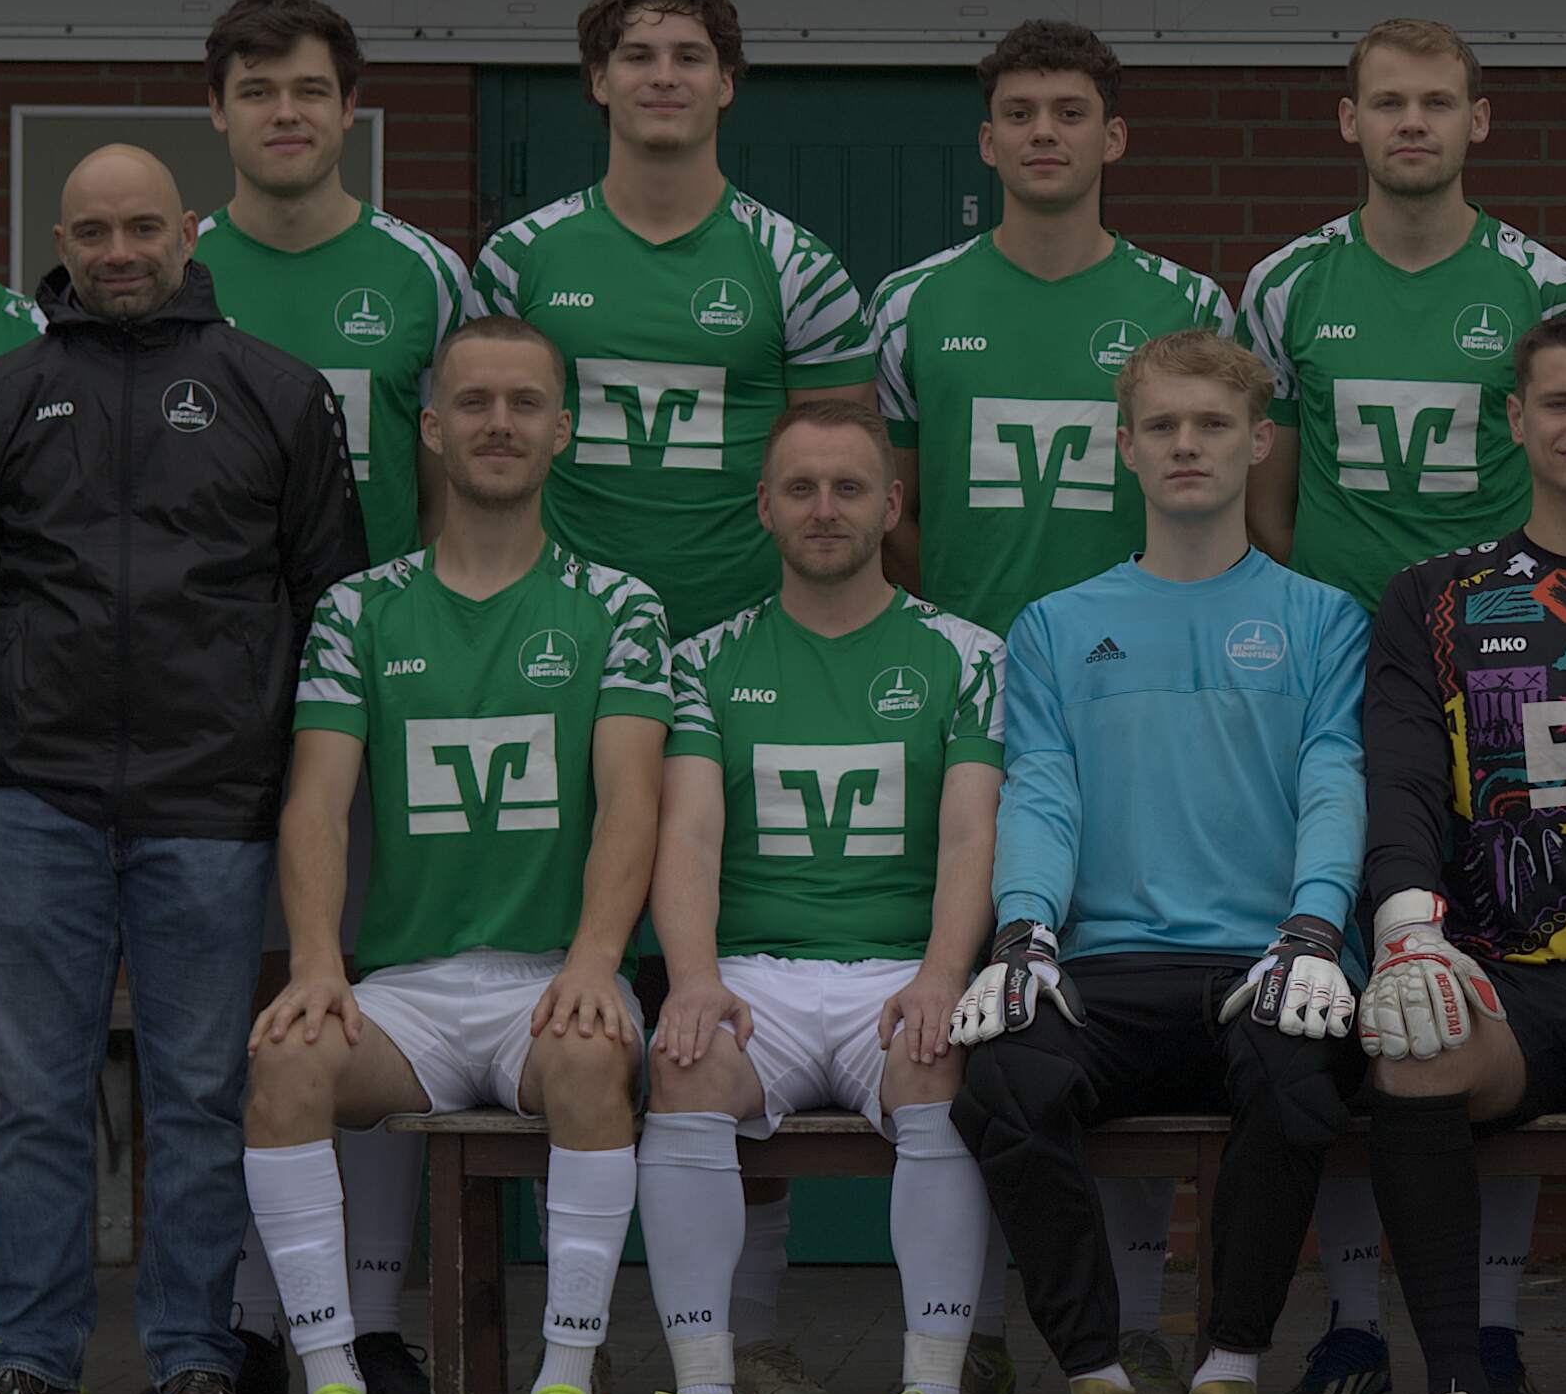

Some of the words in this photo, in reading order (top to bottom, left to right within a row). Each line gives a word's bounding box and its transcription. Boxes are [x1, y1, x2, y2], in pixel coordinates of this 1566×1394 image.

[962, 195, 978, 225] 5
[549, 291, 594, 307] JAKO
[1315, 324, 1356, 340] JAKO
[941, 336, 987, 352] JAKO
[36, 401, 74, 421] JAKO
[1480, 636, 1527, 654] JAKO
[1086, 651, 1126, 664] adidas
[384, 658, 425, 676] JAKO
[730, 687, 776, 703] JAKO
[1434, 973, 1463, 1037] DERBYSTAR
[355, 1258, 401, 1273] JAKO
[922, 1301, 970, 1318] JAKO
[554, 1314, 600, 1332] JAKO
[666, 1309, 712, 1329] JAKO
